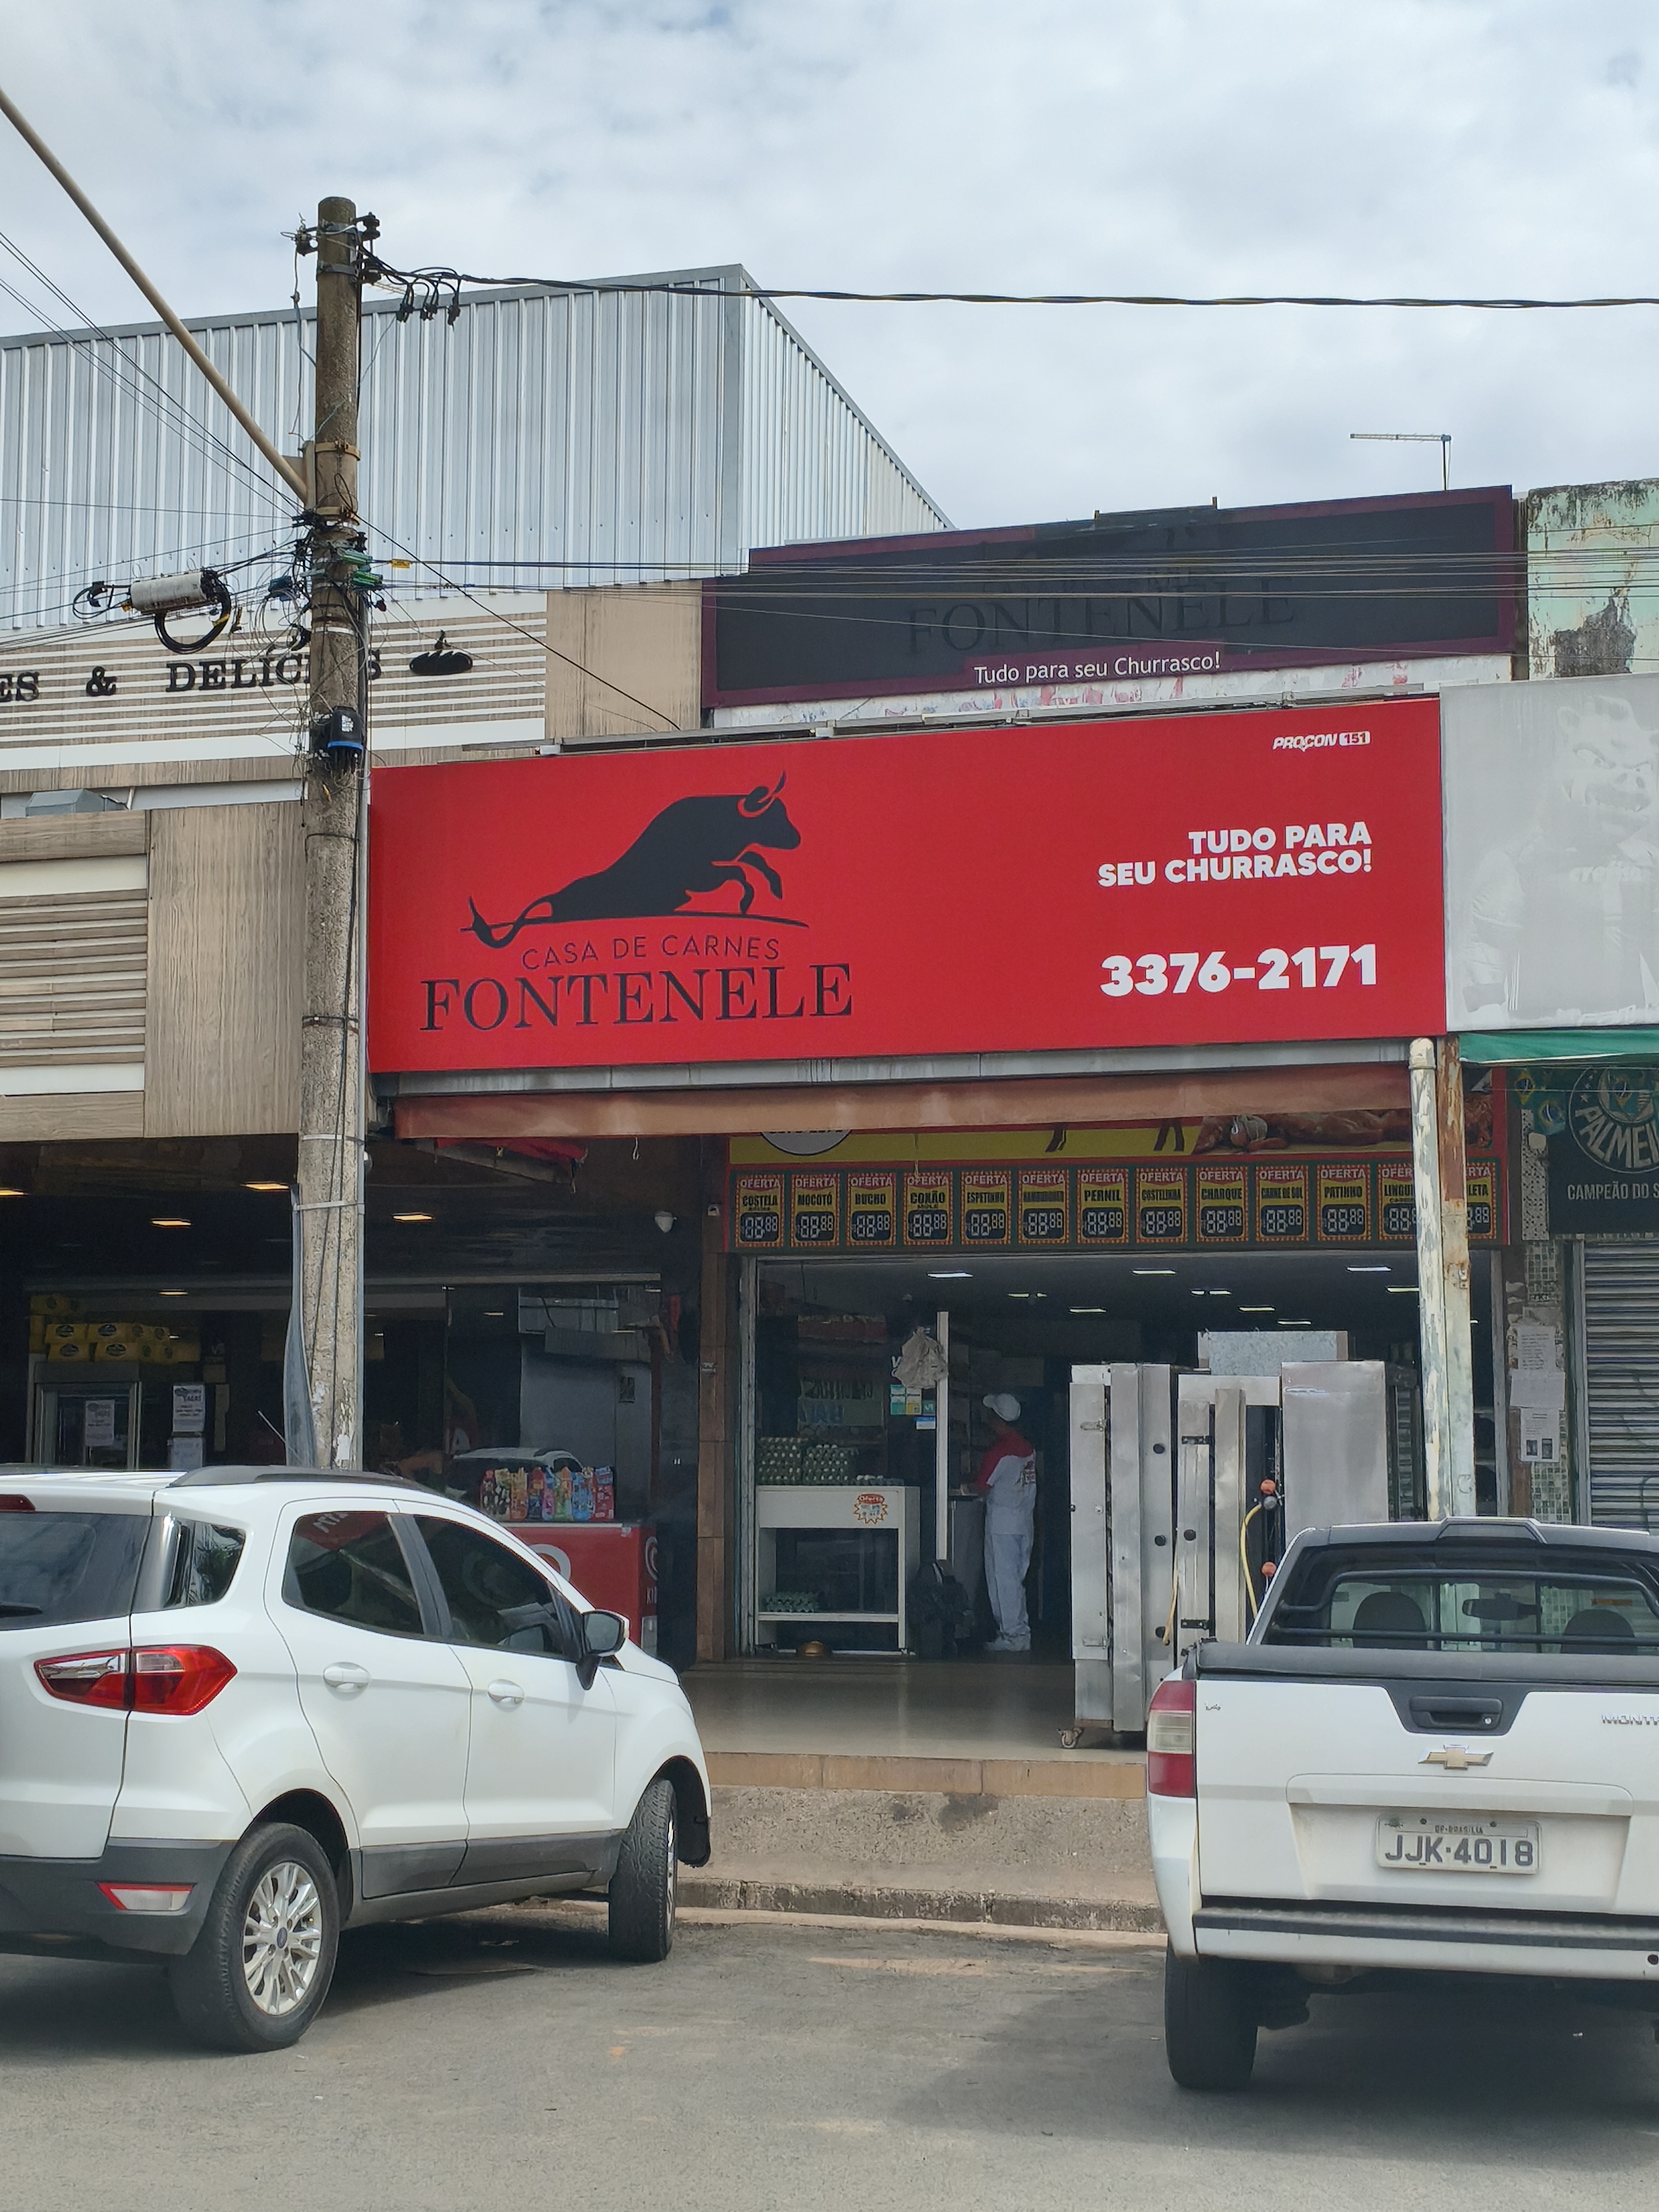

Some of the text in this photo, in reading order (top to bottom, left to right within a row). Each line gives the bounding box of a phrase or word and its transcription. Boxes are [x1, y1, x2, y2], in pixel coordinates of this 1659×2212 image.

[907, 578, 1294, 654] FONTENELE
[974, 651, 1220, 684] Tudo para seu Churrasco!
[86, 666, 117, 697] &
[1272, 732, 1367, 752] PROCON 151
[1188, 821, 1372, 855] TUDO PARA
[1097, 849, 1372, 887] SEU CHURRASCO!
[522, 934, 781, 970] CASA DE CARNES
[1100, 943, 1377, 997] 3376-2171
[419, 962, 853, 1031] FONTENELE
[1575, 1107, 1659, 1168] PALMEI
[1081, 1172, 1124, 1183] OFERTA
[1140, 1171, 1183, 1182] OFERTA
[1199, 1170, 1244, 1181] OFERTA
[1259, 1170, 1304, 1180] OFERTA
[1321, 1169, 1366, 1178] OFERTA
[1382, 1168, 1413, 1178] OFER
[1468, 1166, 1491, 1177] RTA
[740, 1178, 781, 1188] OFERTA
[795, 1177, 836, 1188] OFERTA
[851, 1176, 892, 1187] OFERTA
[907, 1175, 948, 1186] OFERTA
[965, 1175, 1008, 1185] OFERTA
[1022, 1174, 1065, 1184] OFERTA
[1084, 1189, 1122, 1202] PERNIL
[1201, 1188, 1243, 1201] CHARQUE
[1384, 1184, 1413, 1197] LINGUI
[1567, 1181, 1629, 1201] CAMPEÃO
[1632, 1183, 1649, 1199] DO
[855, 1192, 887, 1205] BUCHO
